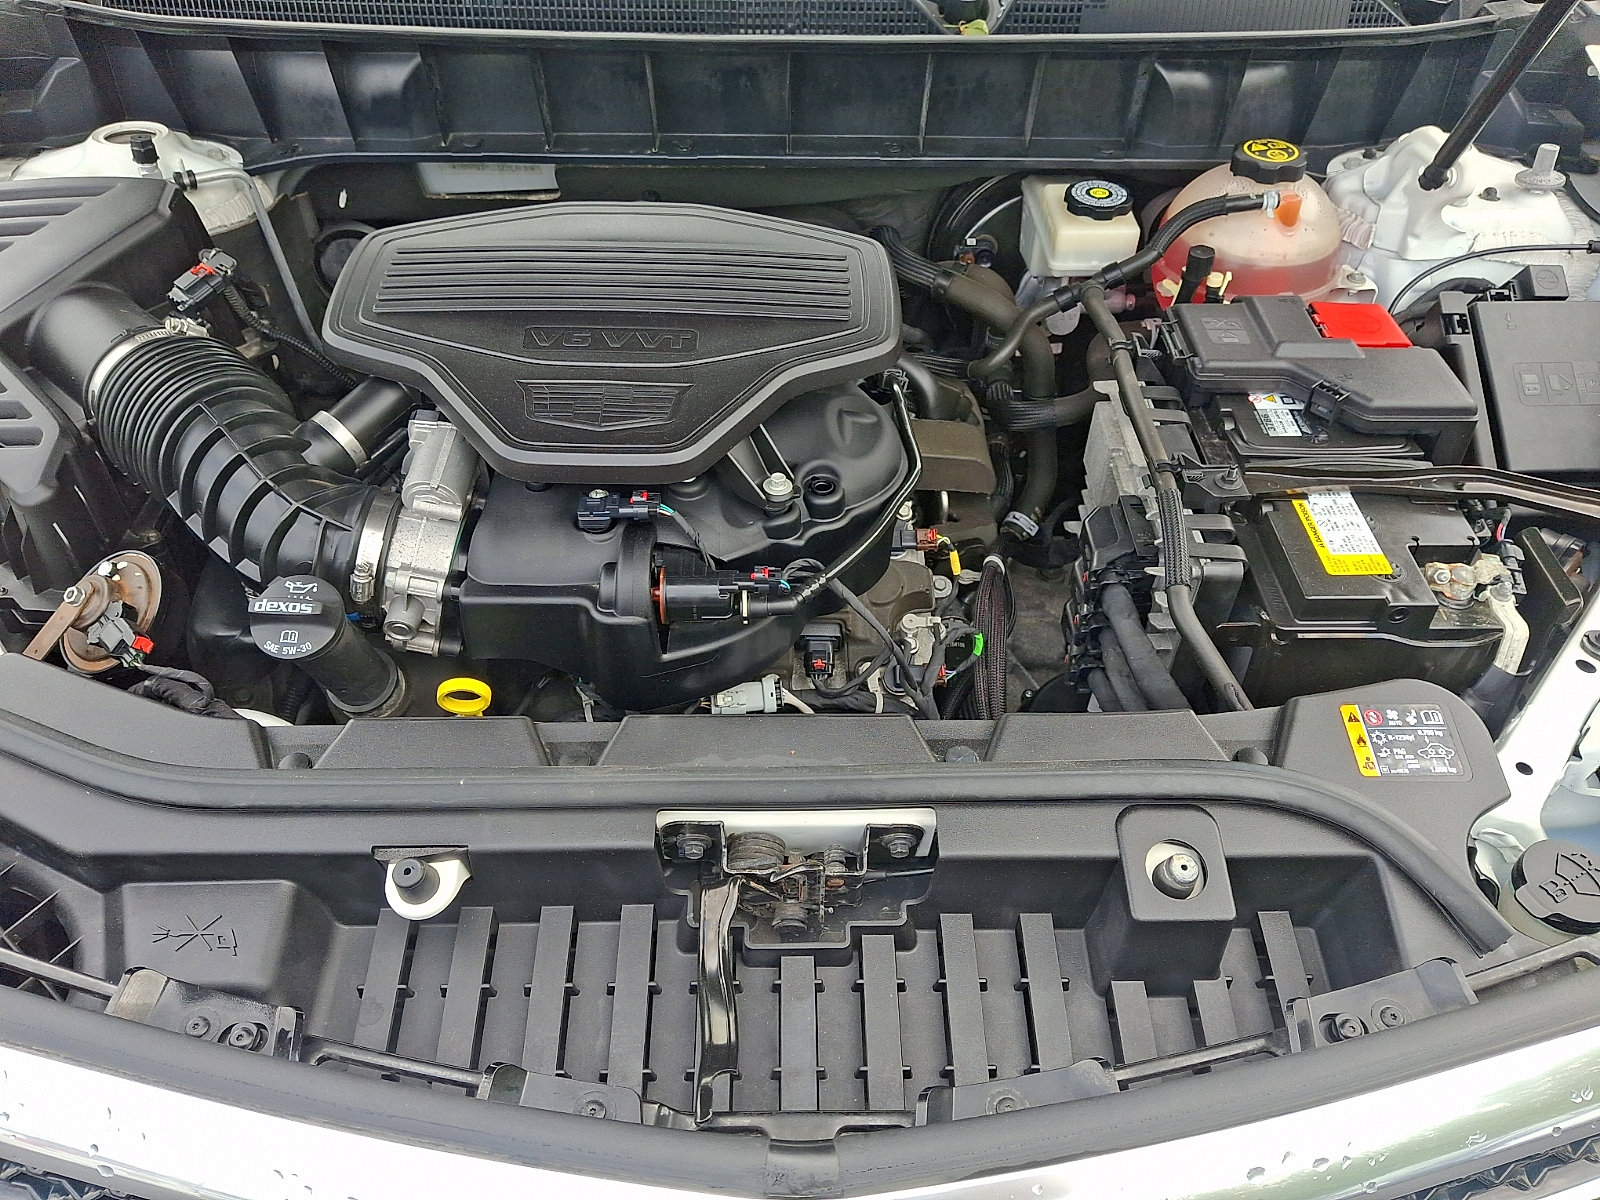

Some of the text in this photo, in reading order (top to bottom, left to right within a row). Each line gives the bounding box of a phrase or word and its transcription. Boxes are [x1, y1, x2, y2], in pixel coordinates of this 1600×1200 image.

[531, 330, 692, 349] V6 VVT
[254, 598, 313, 614] dexos
[264, 640, 312, 655] SAE 5W-30
